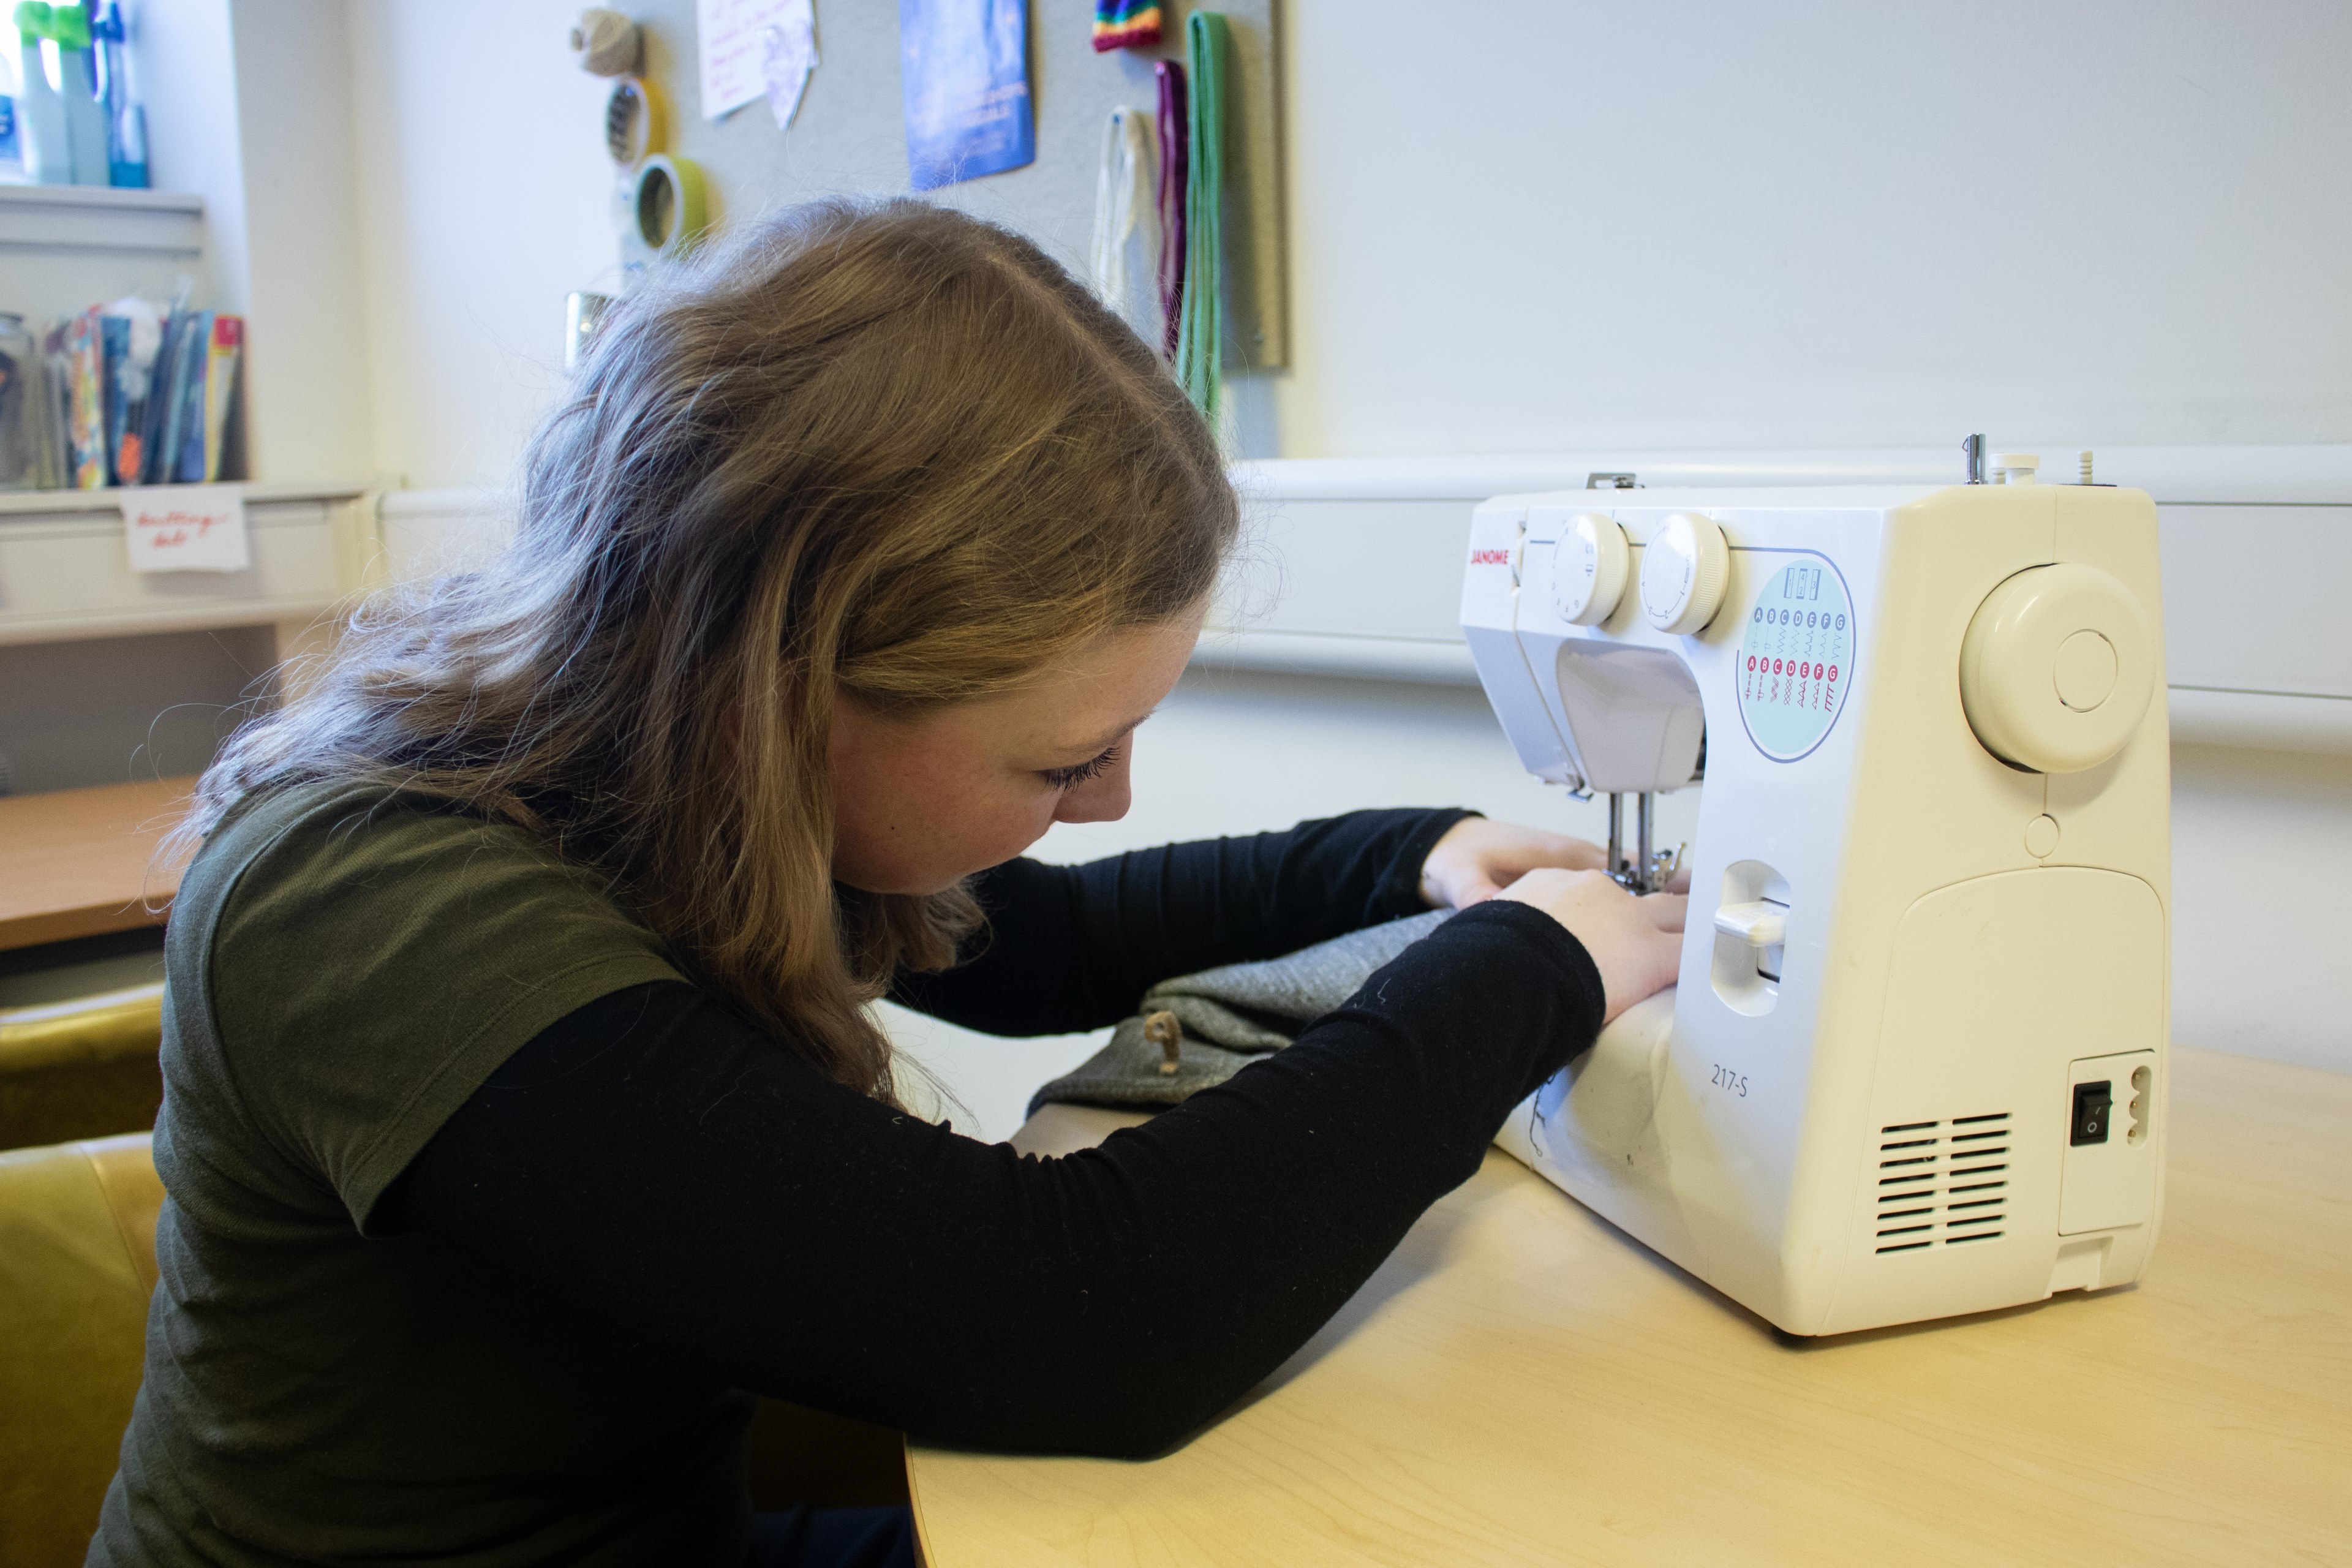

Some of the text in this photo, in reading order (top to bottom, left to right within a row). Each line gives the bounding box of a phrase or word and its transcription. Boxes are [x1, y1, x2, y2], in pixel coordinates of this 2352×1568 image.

[1471, 549, 1509, 564] JANOME
[1800, 573, 1805, 581] 4
[1812, 581, 1816, 589] 3
[1799, 586, 1803, 595] 2
[1755, 609, 1843, 628] A B C D E F G
[1749, 658, 1835, 679] A B C D E F G
[1711, 1064, 1748, 1097] 217-S
